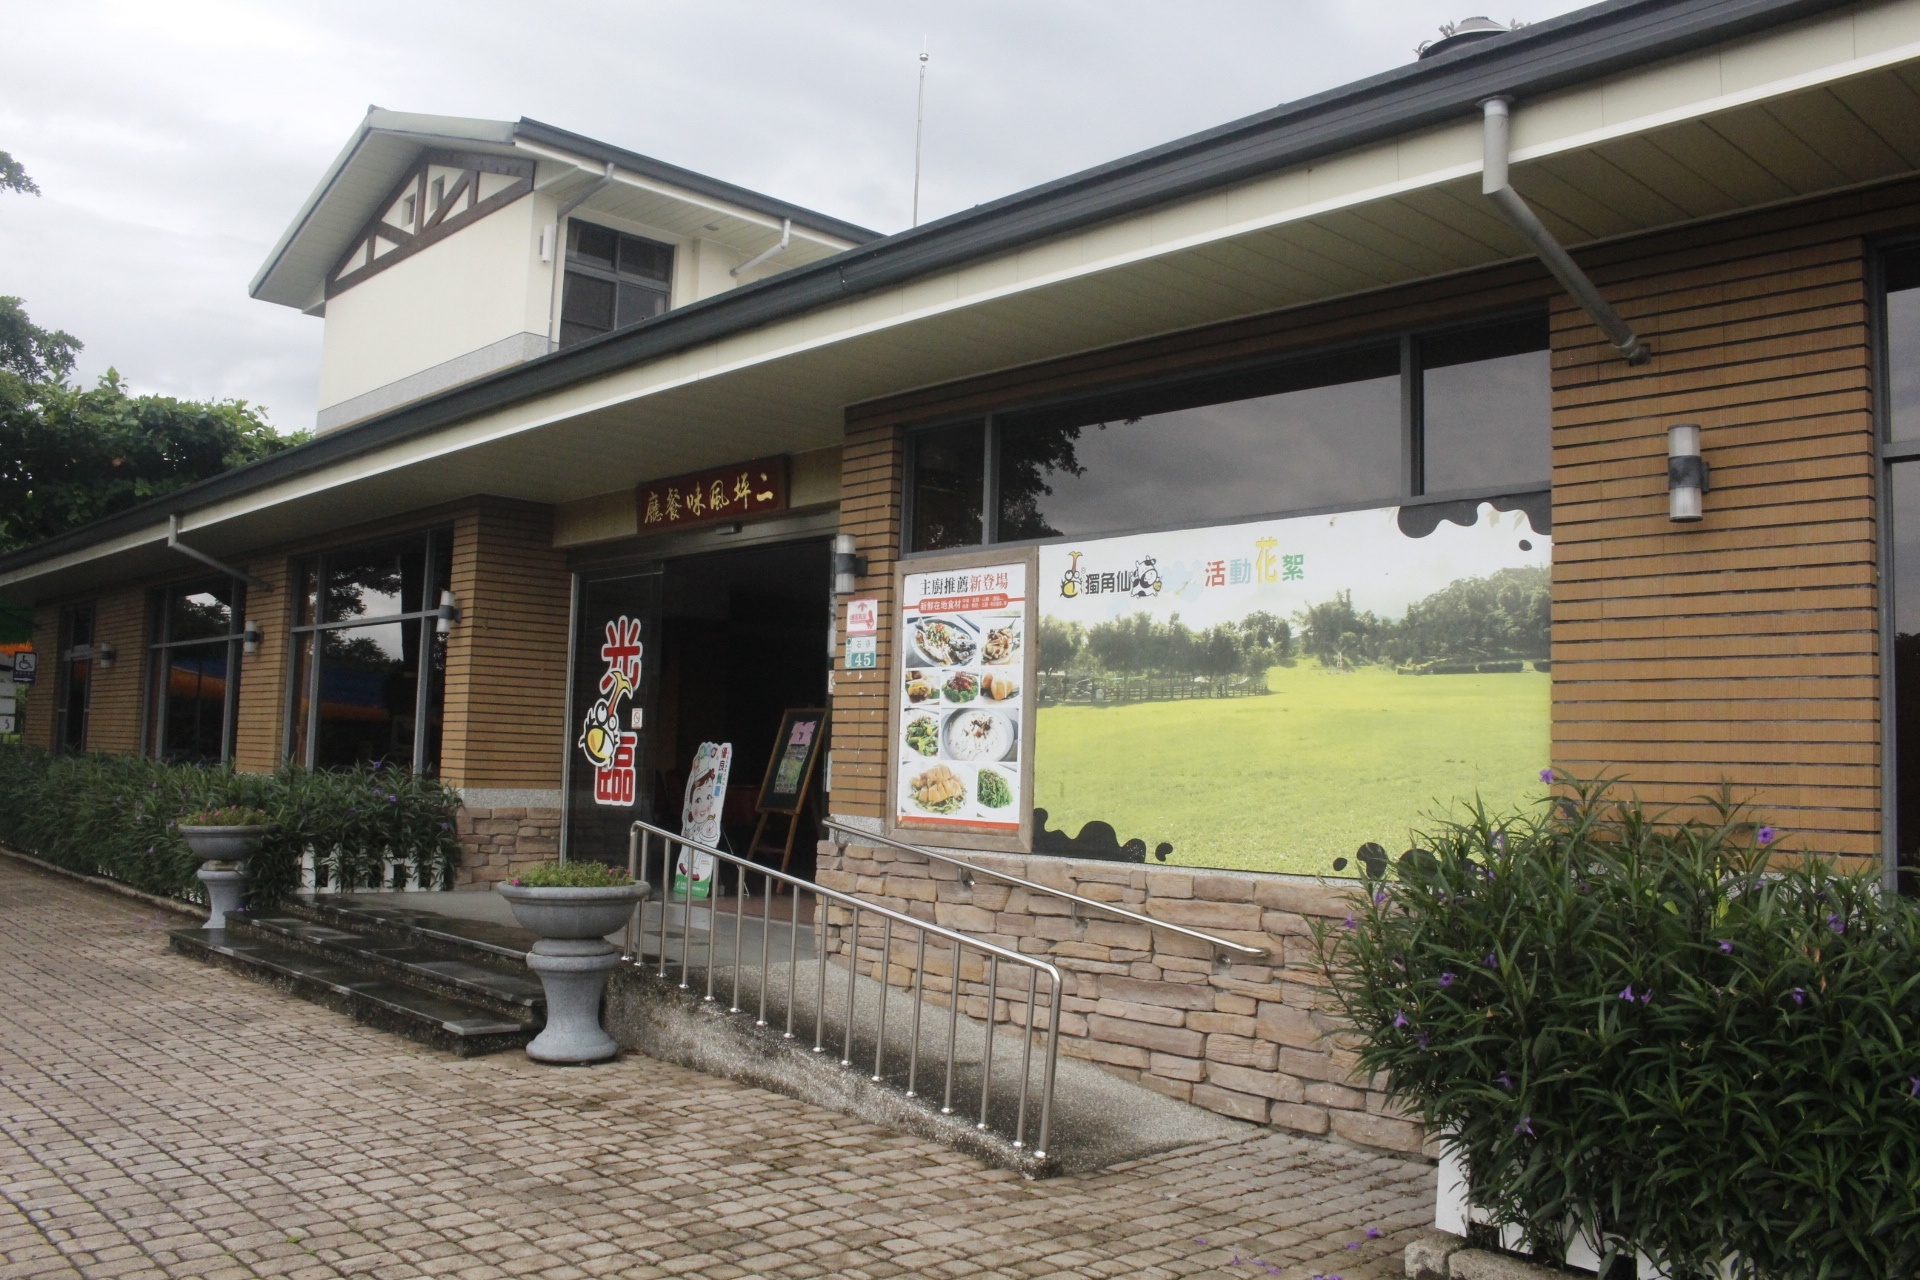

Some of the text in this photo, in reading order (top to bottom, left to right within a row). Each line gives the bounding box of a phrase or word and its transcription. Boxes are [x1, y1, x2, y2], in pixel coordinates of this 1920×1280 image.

[644, 472, 774, 524] 二坪風味餐廳
[1204, 536, 1305, 587] 活動花絮
[920, 572, 1009, 596] 主廚推薦新登場
[1085, 570, 1132, 595] 獨角仙
[920, 600, 961, 611] 新鮮在地食材
[854, 653, 871, 667] 45
